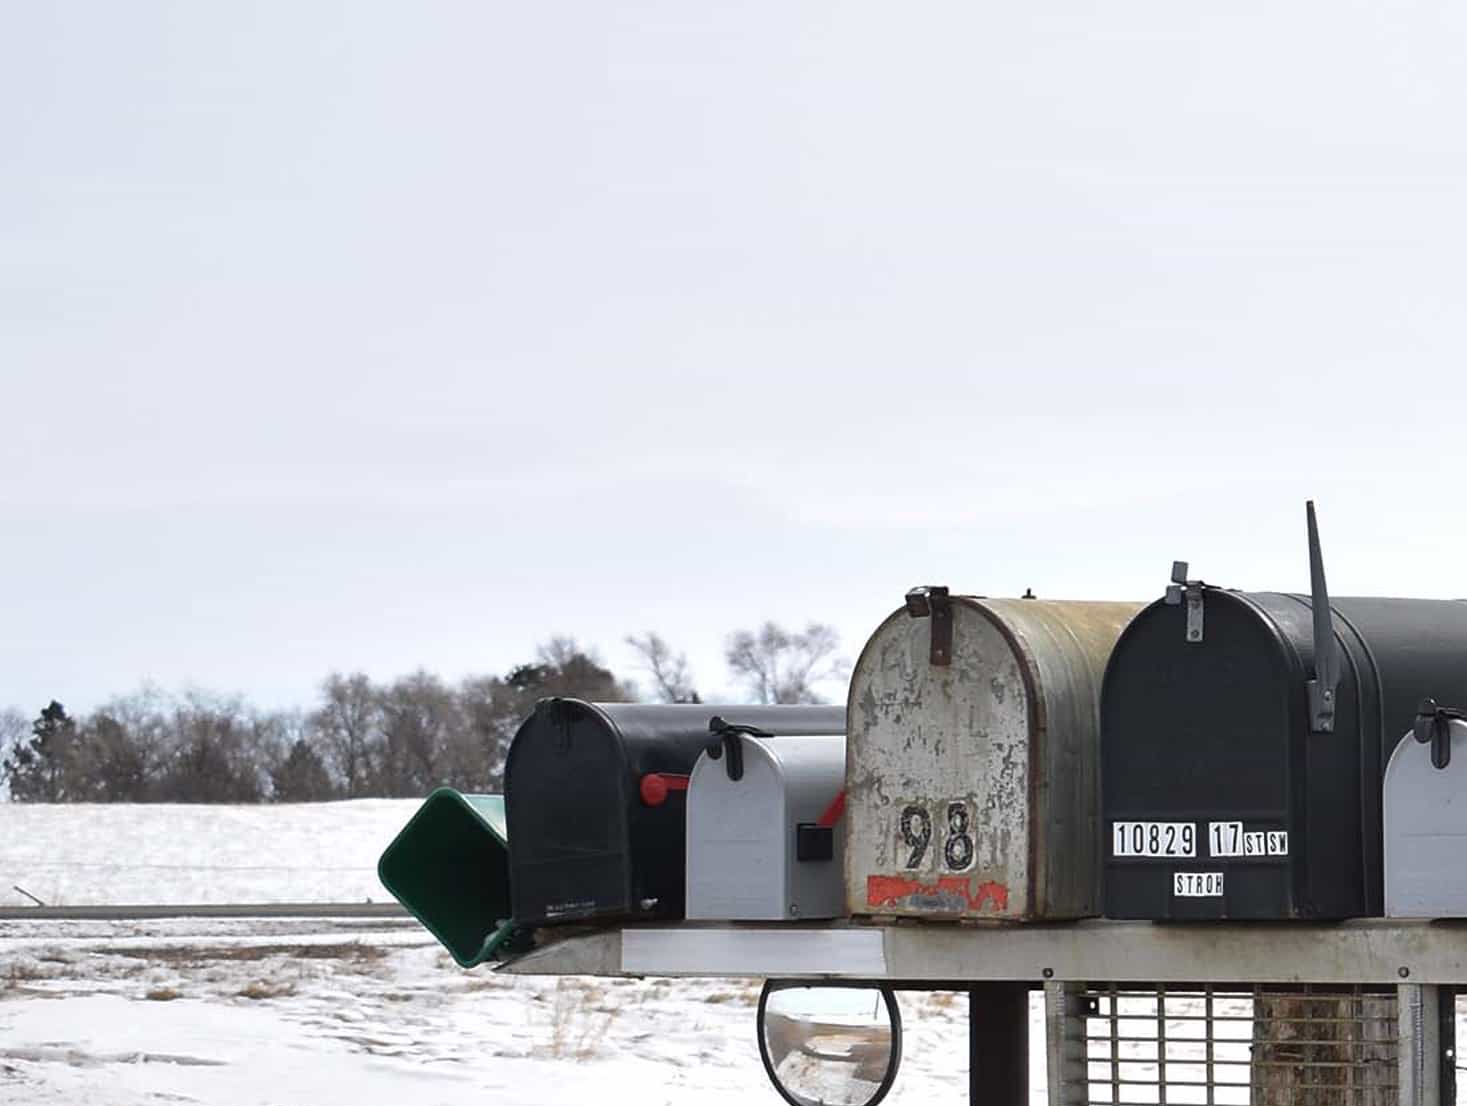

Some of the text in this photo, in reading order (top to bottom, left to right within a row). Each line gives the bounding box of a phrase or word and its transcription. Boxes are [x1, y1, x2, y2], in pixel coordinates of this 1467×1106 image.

[901, 801, 974, 871] 98
[1118, 824, 1194, 854] 10829
[1176, 874, 1224, 894] STROH
